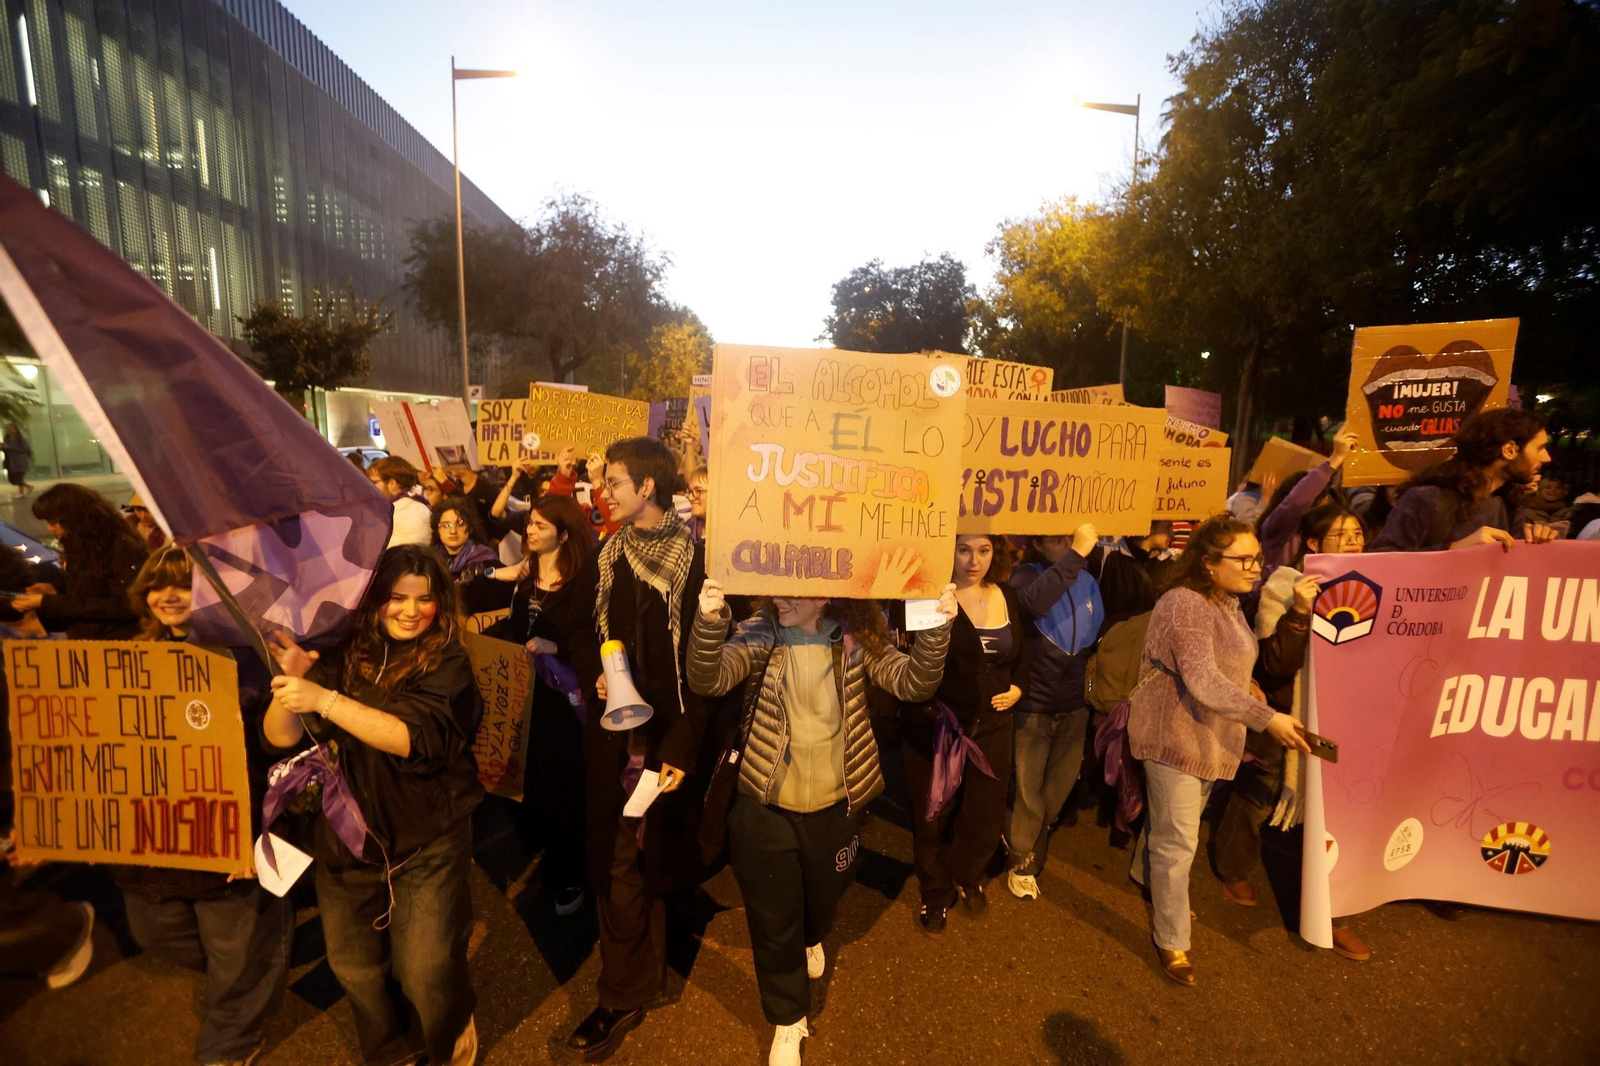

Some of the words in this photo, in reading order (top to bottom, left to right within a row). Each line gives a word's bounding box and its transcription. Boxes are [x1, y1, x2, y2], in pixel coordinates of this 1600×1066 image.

[749, 356, 794, 394] EL
[811, 358, 940, 411] ALCOHOL
[993, 364, 1031, 391] ESTÁ
[480, 401, 513, 422] SOY
[531, 403, 576, 421] PORQUE
[580, 410, 619, 431] DESDE
[622, 419, 638, 432] LA
[532, 387, 549, 401] NO
[552, 391, 604, 410] ESTAMOS
[608, 400, 648, 421] TODAS
[1378, 404, 1404, 419] NO
[1407, 404, 1430, 414] me
[1432, 400, 1466, 413] GUSTA
[481, 418, 527, 441] ARTÍS
[567, 427, 582, 444] NO
[585, 428, 597, 445] SE
[750, 405, 795, 428] QUE
[804, 409, 821, 432] A
[829, 408, 884, 453] ÉL
[903, 419, 945, 458] LO
[1000, 416, 1092, 458] LUCHO
[1097, 422, 1147, 460] PARA
[1381, 424, 1421, 432] cuando
[1420, 418, 1461, 435] CALLAS
[487, 442, 510, 461] LA
[1197, 459, 1212, 467] es
[1059, 470, 1137, 514] mañana
[1156, 497, 1191, 511] IDA.
[738, 489, 764, 523] A
[859, 502, 893, 541] ME
[731, 539, 853, 580] CULPABLE
[1395, 586, 1468, 603] UNIVERSIDAD
[1467, 575, 1529, 641] LA
[1386, 619, 1443, 637] CÓRDOBA
[12, 647, 41, 689] ES
[55, 648, 90, 689] UN
[167, 649, 211, 692] TAN
[16, 694, 100, 740] POBRE
[117, 694, 178, 741] QUE
[493, 684, 510, 718] VOZ
[508, 719, 524, 751] QUE
[17, 744, 75, 794] GRITA
[80, 743, 128, 795] MAS
[140, 746, 169, 797] UN
[180, 744, 234, 795] GOL
[19, 796, 64, 850] QUE
[74, 797, 121, 852] UNA
